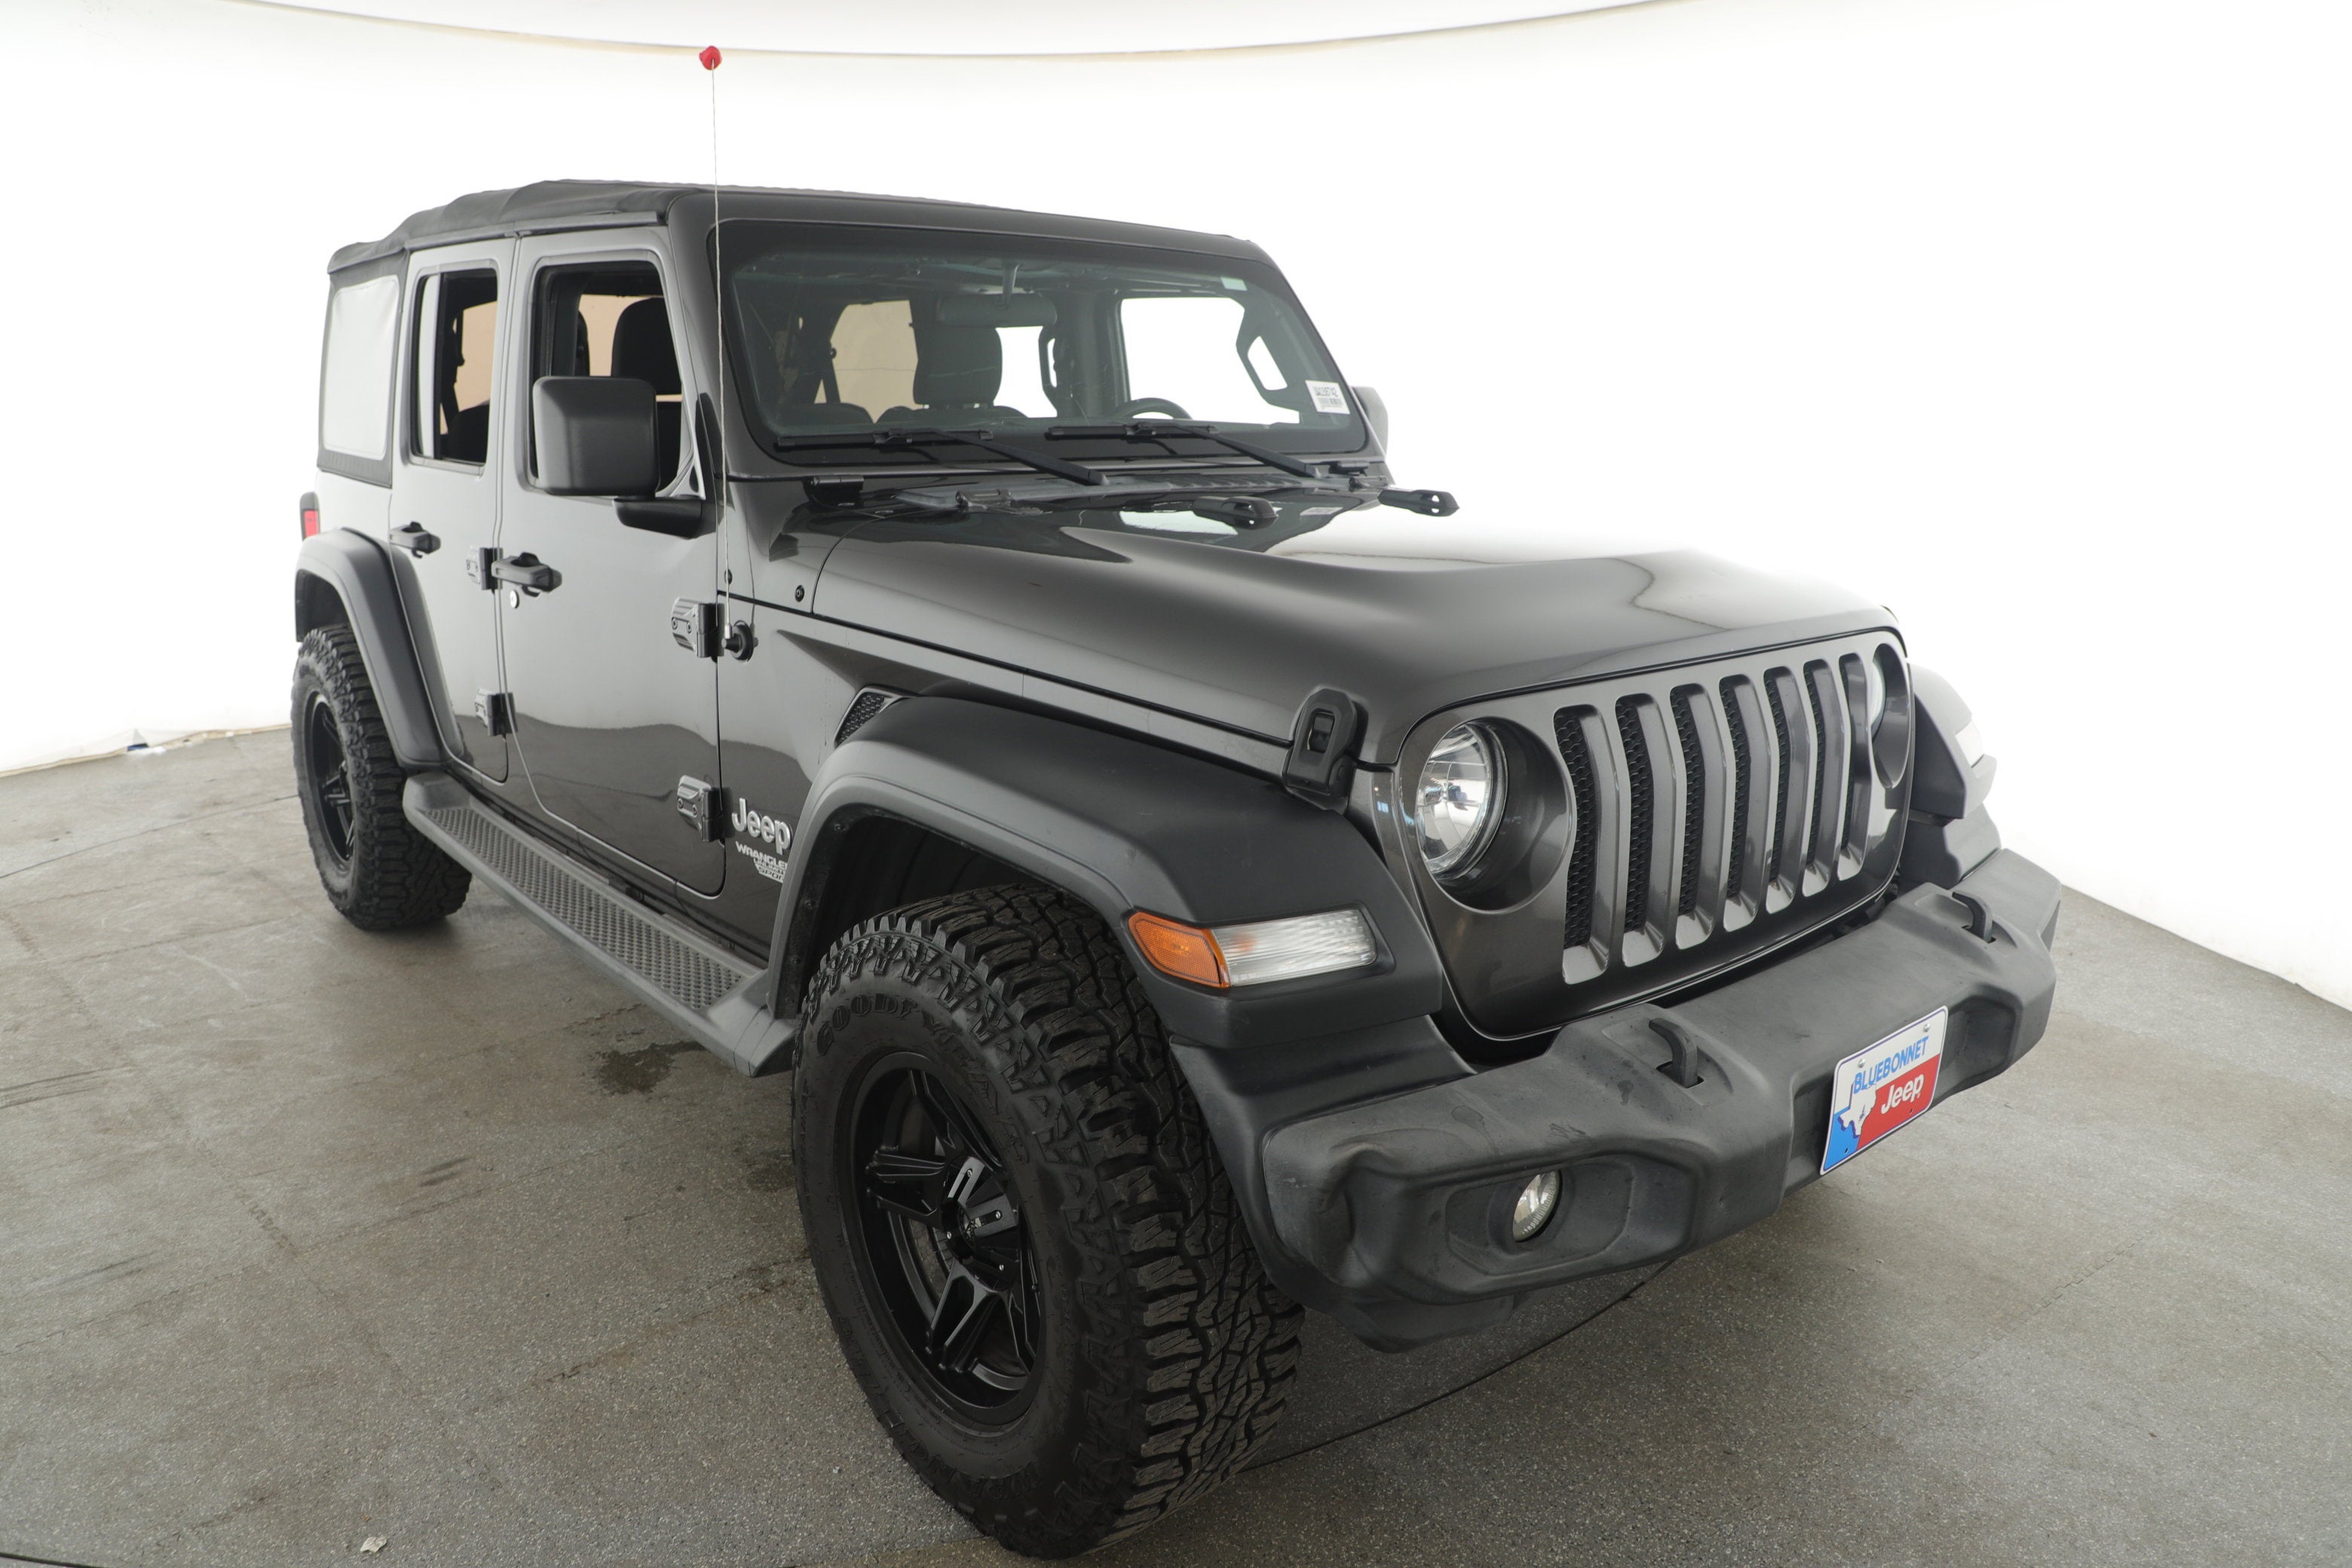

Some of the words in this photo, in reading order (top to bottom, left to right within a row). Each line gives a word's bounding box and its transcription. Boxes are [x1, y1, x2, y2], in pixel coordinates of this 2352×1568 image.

[731, 798, 791, 856] Jeep
[1853, 1035, 1929, 1094] BLUEBONNET
[1880, 1073, 1925, 1115] Jeep
